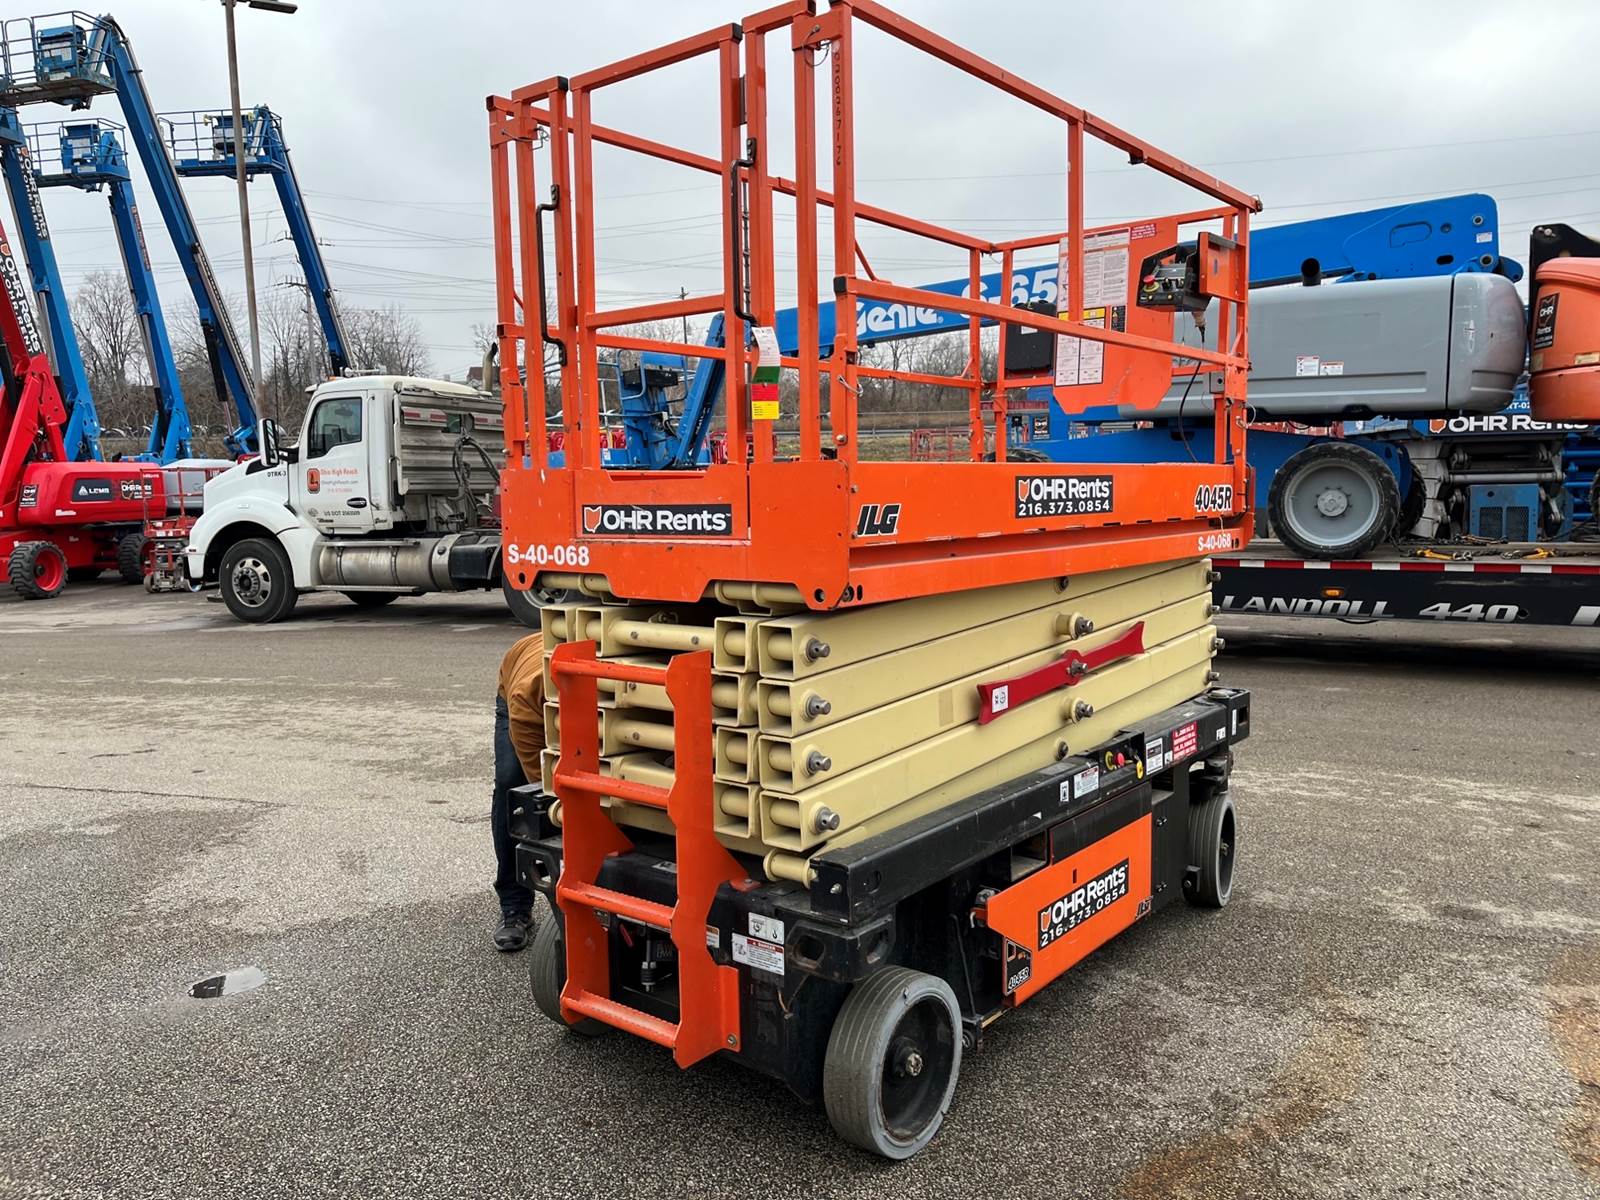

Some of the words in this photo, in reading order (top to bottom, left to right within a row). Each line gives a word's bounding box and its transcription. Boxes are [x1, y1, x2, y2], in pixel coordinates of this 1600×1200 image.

[24, 158, 38, 193] OHR
[32, 193, 48, 238] Rents
[5, 257, 24, 298] OHR
[18, 299, 41, 352] Rents
[1450, 416, 1507, 432] OHR
[1030, 478, 1066, 501] OHR
[1068, 478, 1110, 499] Rents
[1195, 485, 1232, 512] 4045R
[602, 510, 653, 530] OHR
[657, 510, 727, 531] Rents
[857, 504, 901, 537] JLG
[1018, 499, 1110, 517] 216.373.0854
[508, 544, 590, 566] S-40-068
[1198, 533, 1231, 551] S-40-068
[1221, 595, 1395, 618] LANDOLL
[1418, 602, 1519, 623] 440
[1052, 888, 1085, 924] OHR
[1087, 866, 1126, 904] Rents
[1041, 883, 1126, 947] 216.373.0854
